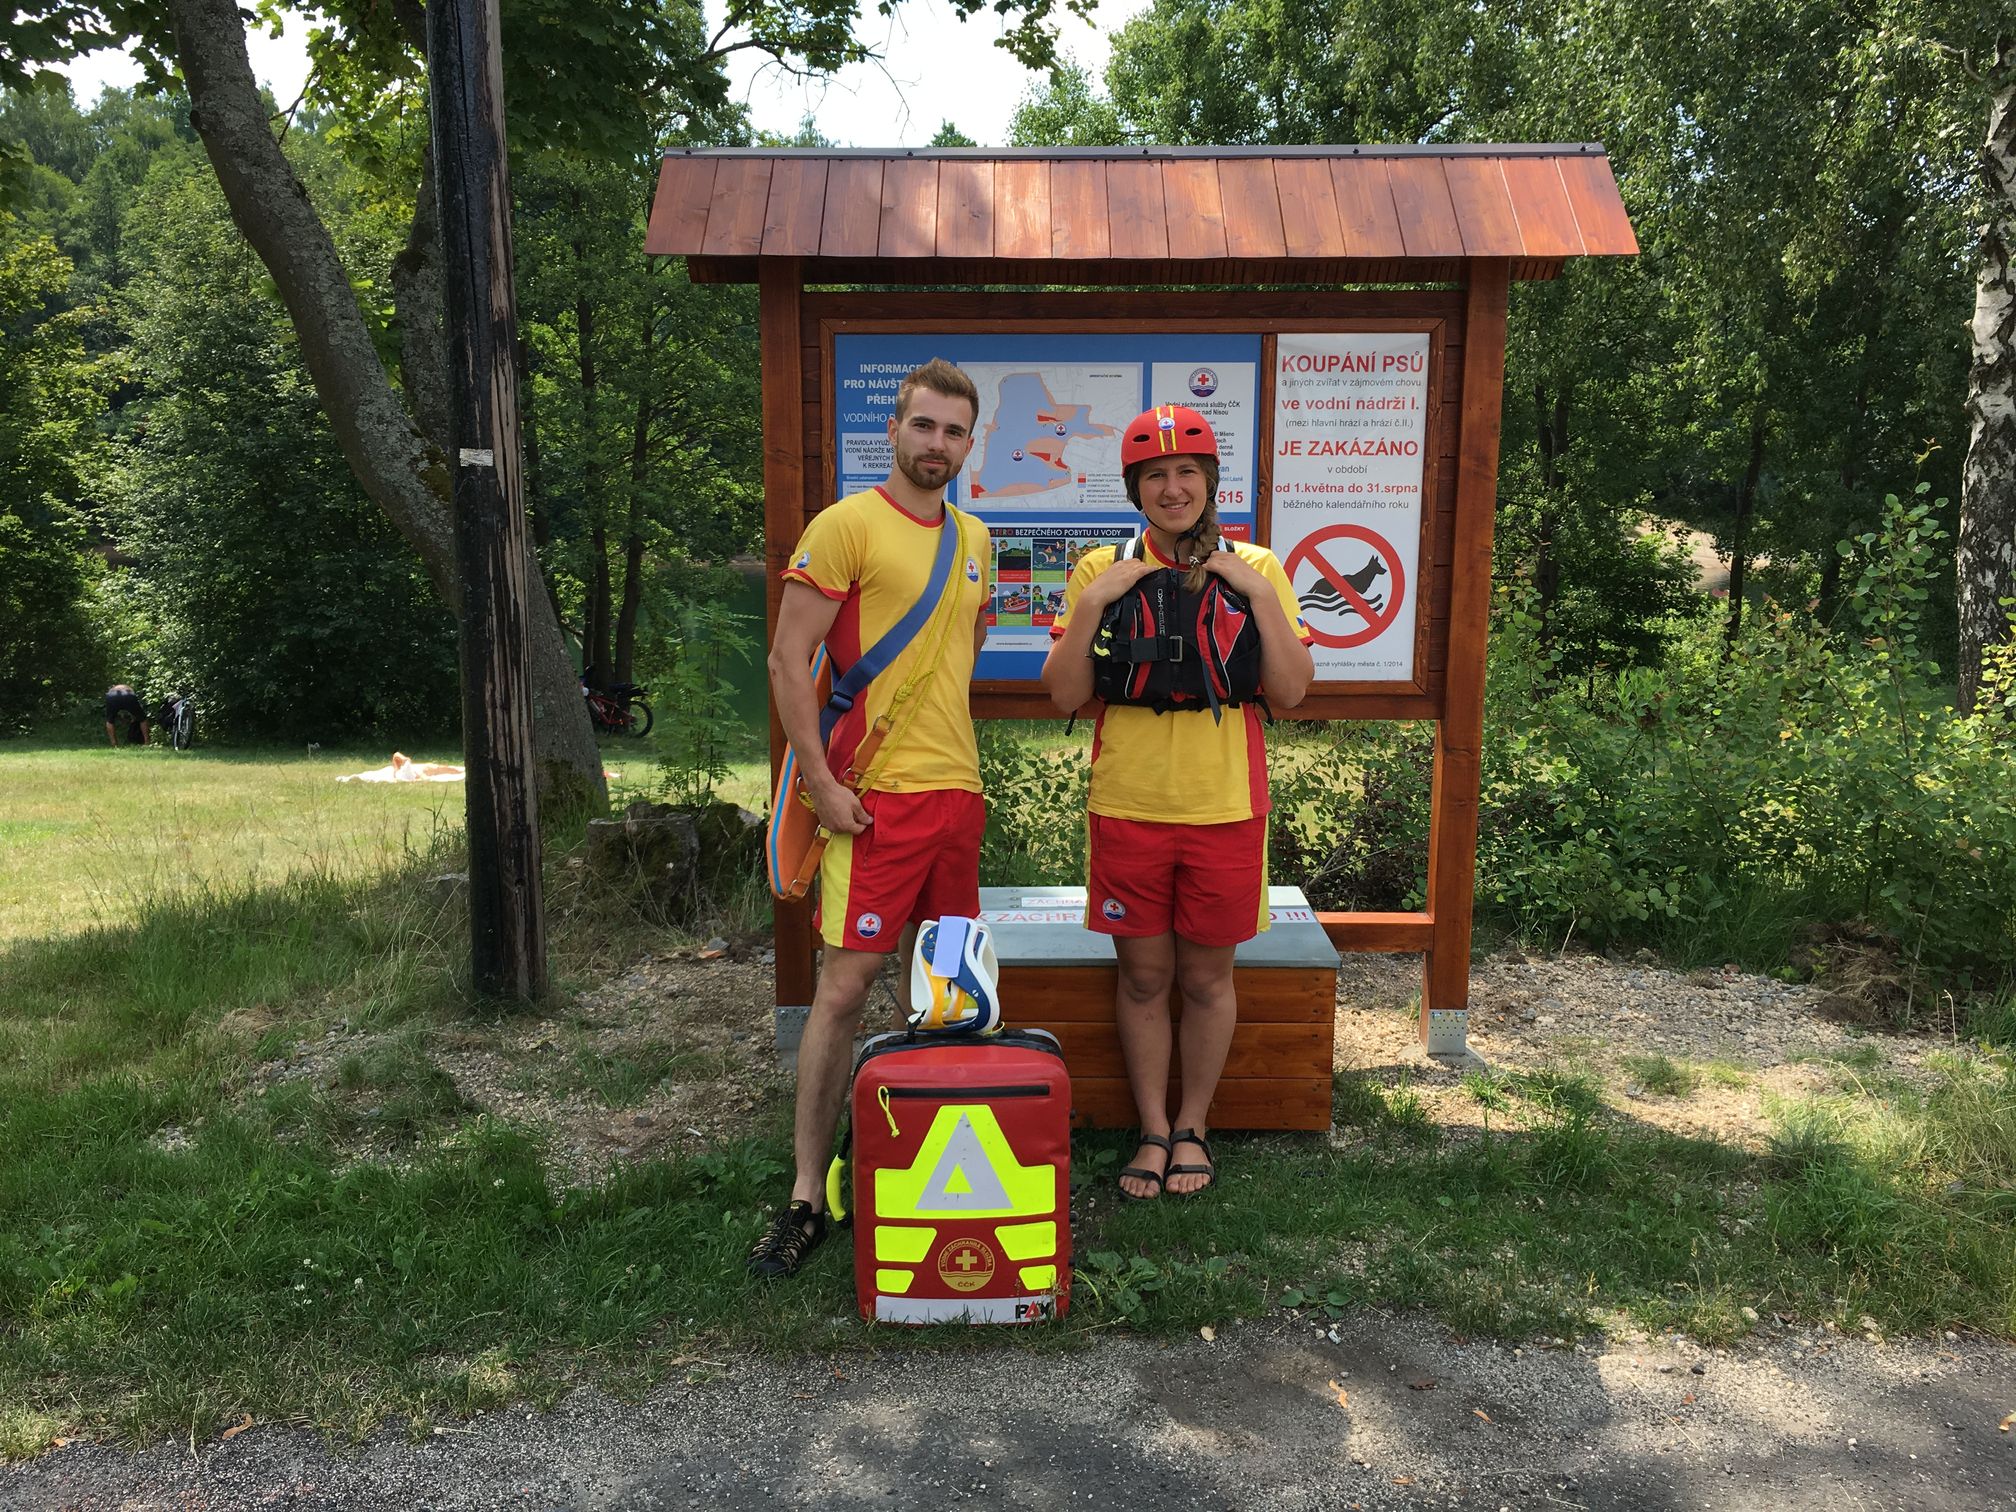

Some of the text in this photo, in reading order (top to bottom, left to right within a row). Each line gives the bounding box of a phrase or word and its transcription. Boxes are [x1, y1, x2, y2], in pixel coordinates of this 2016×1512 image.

[1281, 350, 1424, 373] KOUPÁNÍ PSŮ
[844, 377, 904, 389] PRO NÁVŠT
[1289, 378, 1314, 389] jiných
[1316, 378, 1340, 387] zvířat
[1343, 379, 1347, 387] v
[1350, 378, 1393, 389] zájmovém
[1395, 378, 1421, 387] chovu
[866, 393, 897, 405] PŘEH
[1282, 399, 1300, 410] ve
[1305, 396, 1351, 410] vodní
[1356, 396, 1406, 410] nádrži
[843, 411, 888, 423] VODNÍHO
[1285, 418, 1309, 429] (mezi
[1311, 418, 1337, 427] hlavní
[1339, 418, 1361, 427] hrází
[1371, 418, 1392, 427] hrází
[1278, 437, 1419, 457] JE ZAKÁZÁNO
[1327, 464, 1368, 474] v období
[1275, 482, 1418, 495] od 1.května do 31.srpna
[1218, 490, 1244, 504] 515
[1282, 499, 1409, 509] běžného kalendářního roku
[1015, 527, 1063, 536] BEZPEČNÉHO
[1015, 1300, 1053, 1319] PAX
